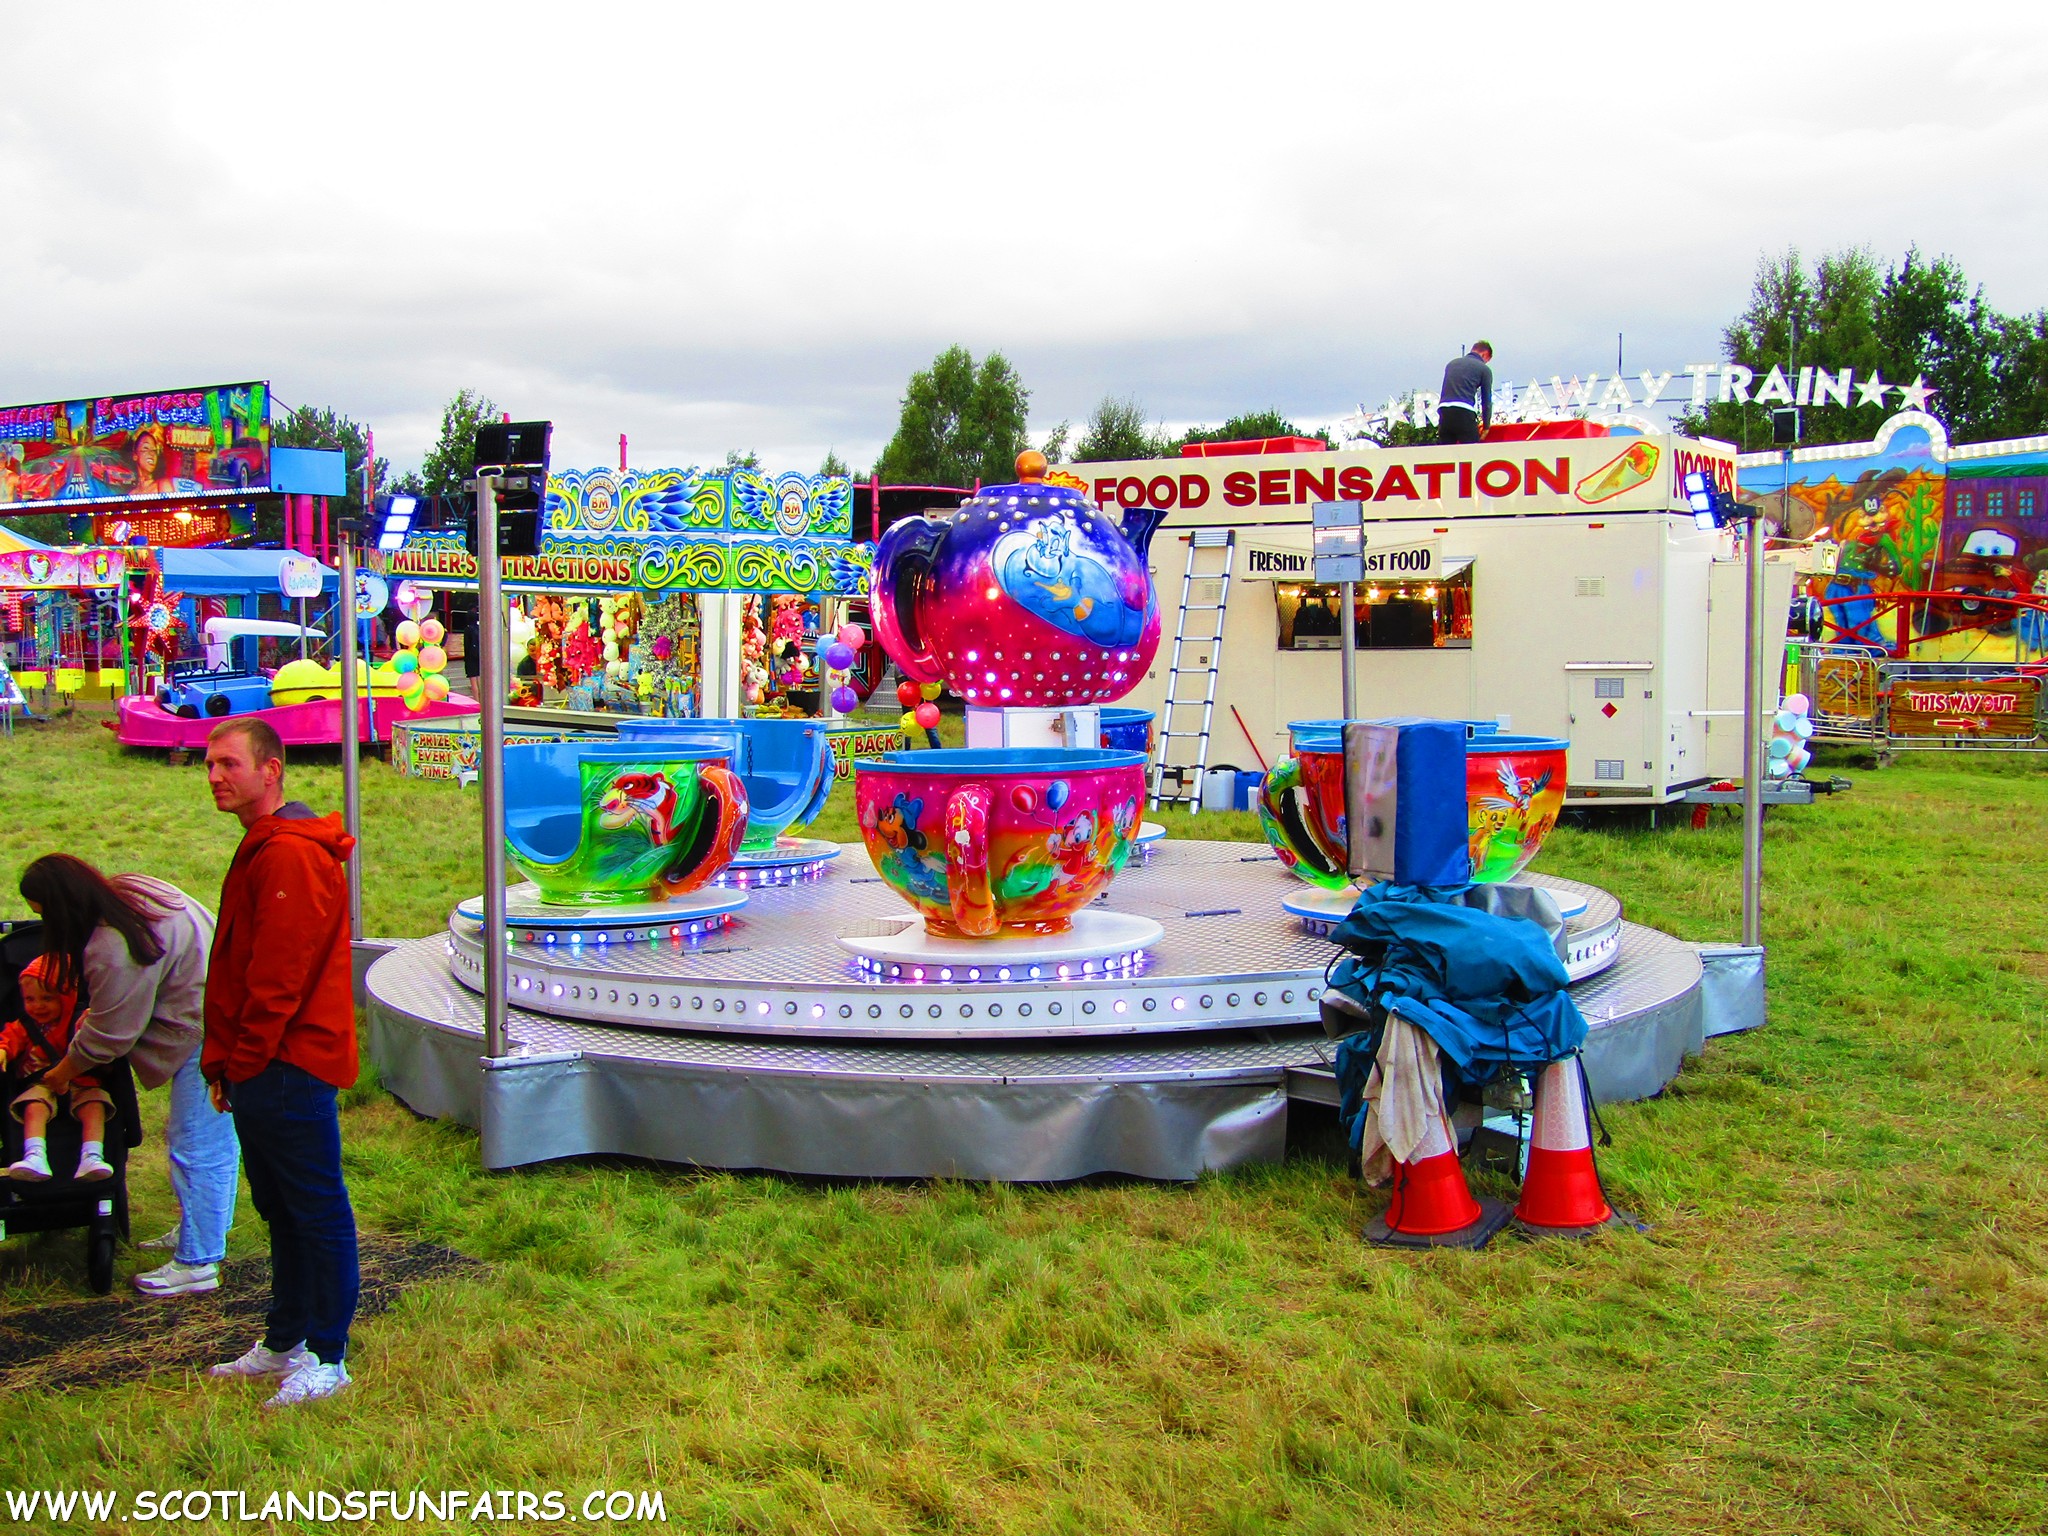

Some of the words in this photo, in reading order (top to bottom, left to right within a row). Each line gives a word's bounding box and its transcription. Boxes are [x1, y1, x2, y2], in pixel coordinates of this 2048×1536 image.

[1414, 368, 1673, 429] RNAWAY
[1685, 362, 1852, 409] TRAIN
[65, 483, 92, 499] ONE
[1094, 474, 1211, 512] FOOD
[1222, 456, 1571, 508] SENSATION
[591, 497, 609, 509] BM
[784, 502, 801, 514] BM
[392, 549, 478, 576] MILLER'S
[500, 553, 631, 584] TTRACTIONS
[1249, 550, 1307, 571] FRESHLY
[1390, 549, 1431, 571] FOOD
[1909, 693, 1947, 713] THIS
[1948, 692, 1982, 715] WAY
[1982, 693, 2017, 713] OUT
[418, 732, 451, 748] PRIZE
[854, 733, 897, 754] BACK
[416, 749, 453, 763] EVERY
[421, 765, 450, 780] TIME
